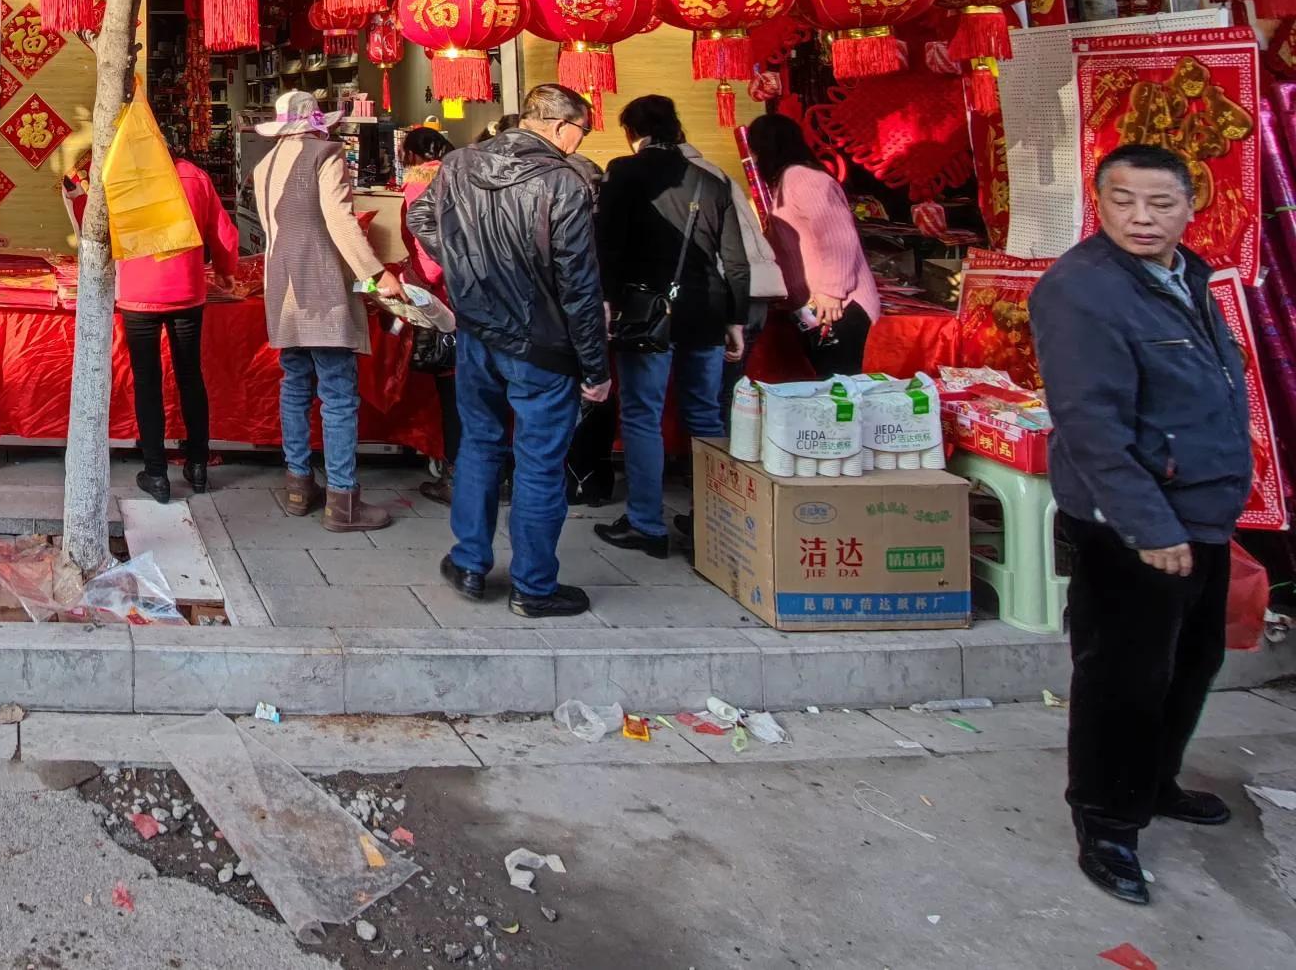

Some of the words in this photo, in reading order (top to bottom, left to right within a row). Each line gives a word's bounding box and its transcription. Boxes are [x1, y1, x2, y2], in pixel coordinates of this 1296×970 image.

[8, 15, 48, 55] 福
[16, 112, 54, 149] 福
[796, 430, 826, 440] JIEDA
[874, 424, 903, 435] JIEDA
[874, 434, 897, 444] CUP
[796, 440, 819, 450] CUP
[799, 537, 864, 568] 洁达
[888, 551, 943, 569] 精品纸杯
[804, 568, 826, 579] JIE
[838, 568, 860, 577] DA
